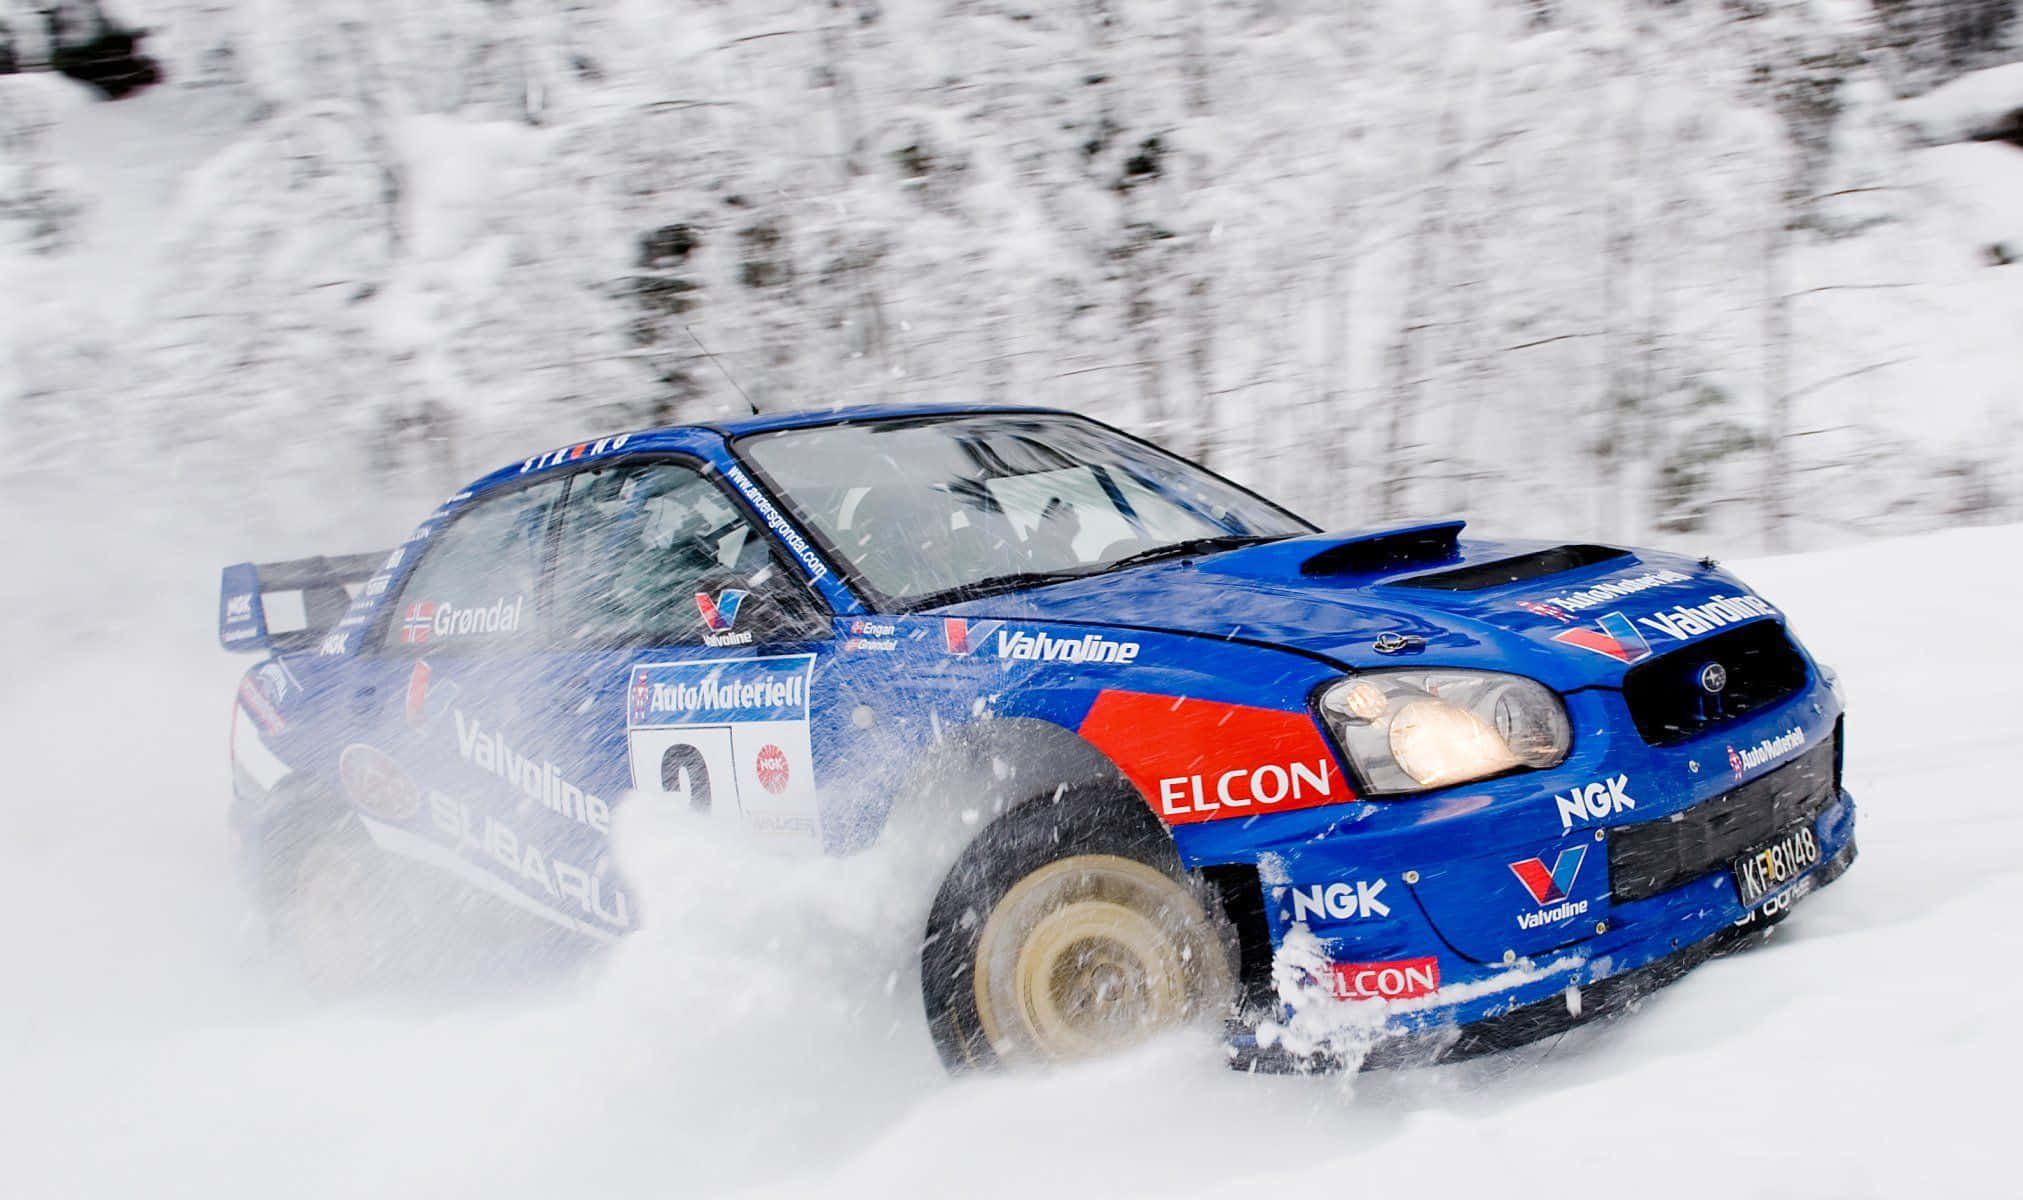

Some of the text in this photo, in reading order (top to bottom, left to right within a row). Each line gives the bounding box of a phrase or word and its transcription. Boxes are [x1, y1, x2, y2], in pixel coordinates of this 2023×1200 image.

[727, 465, 828, 577] www.andersgrondal.com
[434, 595, 523, 636] Grøndal
[1638, 594, 1776, 640] Valvoline
[703, 631, 752, 647] Valvoline
[998, 630, 1140, 664] Valvoline
[650, 676, 802, 712] AutoMateriell
[1739, 726, 1805, 771] AutoMateriell
[454, 709, 609, 834] Valvoline
[1160, 759, 1331, 815] ELCON
[1554, 774, 1635, 828] NGK
[428, 790, 629, 928] SUBARU
[1743, 827, 1817, 899] KF 81148
[1292, 878, 1391, 921] NGK
[1517, 900, 1588, 931] Valvoline
[1329, 965, 1435, 997] LCON
